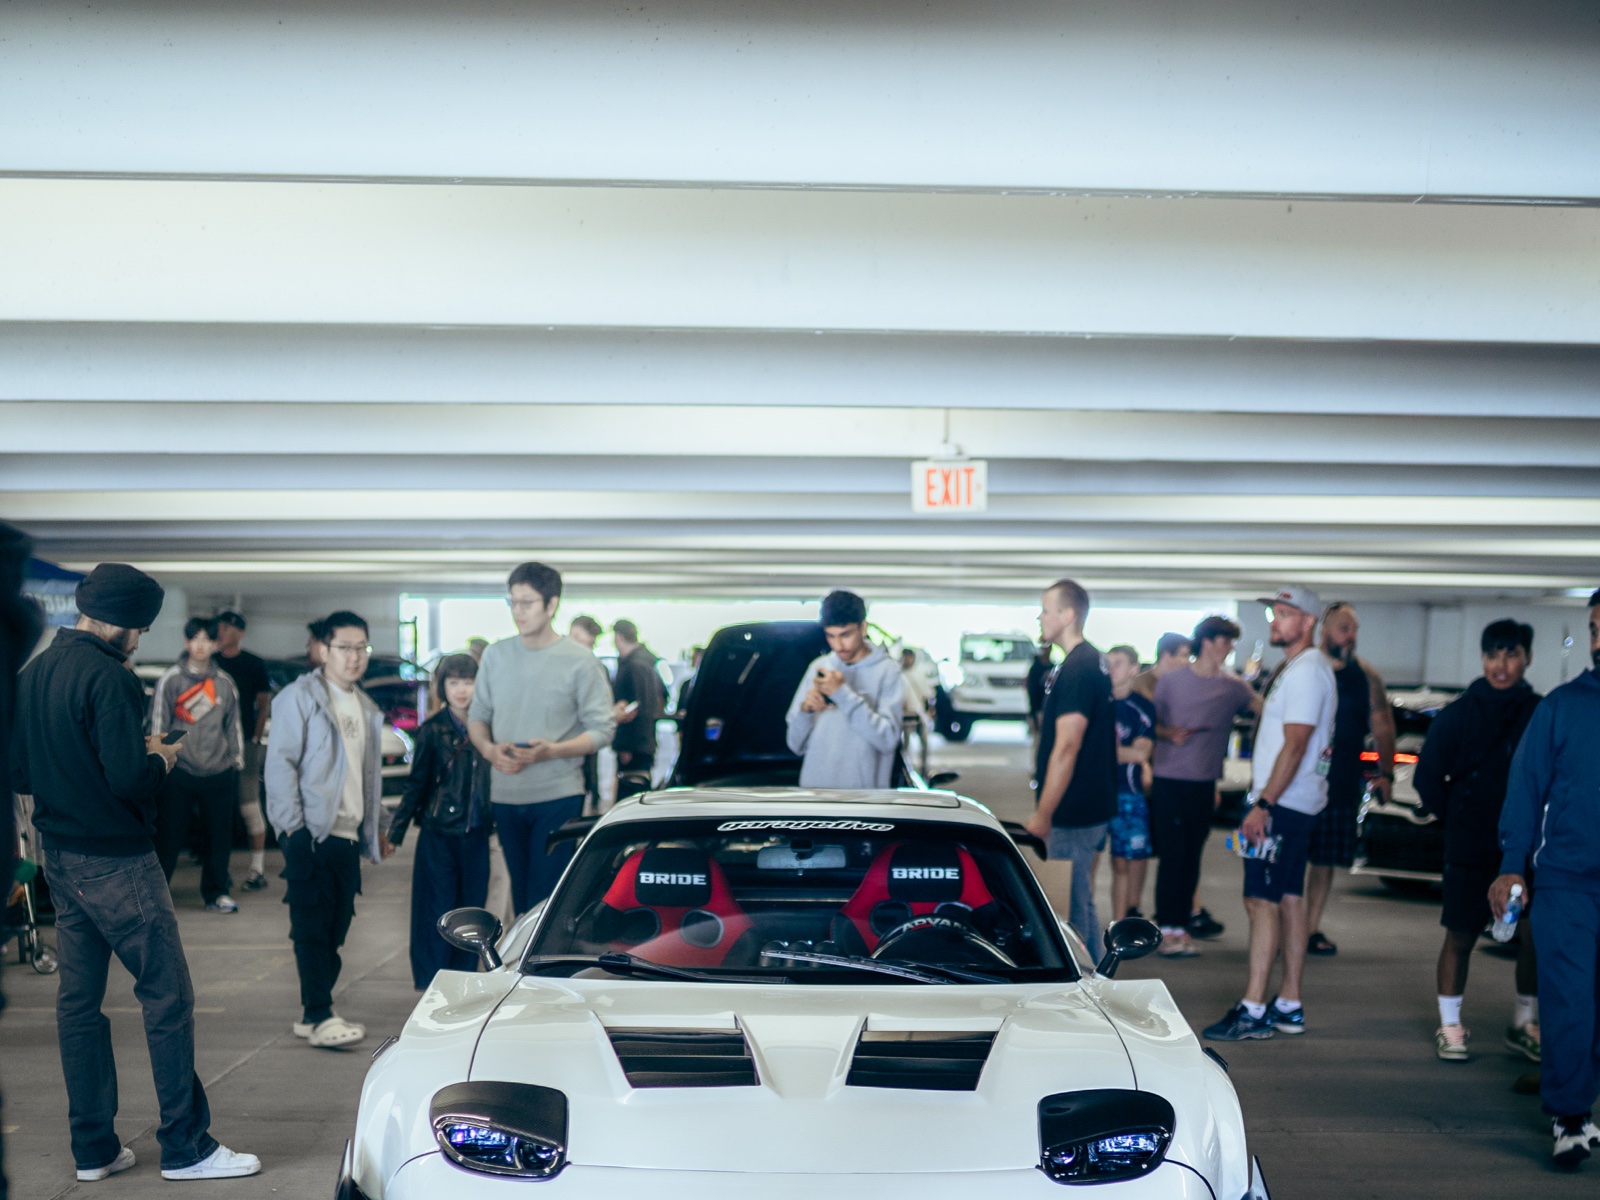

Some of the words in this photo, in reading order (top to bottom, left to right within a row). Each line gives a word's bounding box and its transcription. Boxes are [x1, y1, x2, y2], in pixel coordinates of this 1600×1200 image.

[925, 467, 975, 507] EXIT
[639, 872, 706, 885] BRIDE
[892, 868, 960, 880] BRIDE
